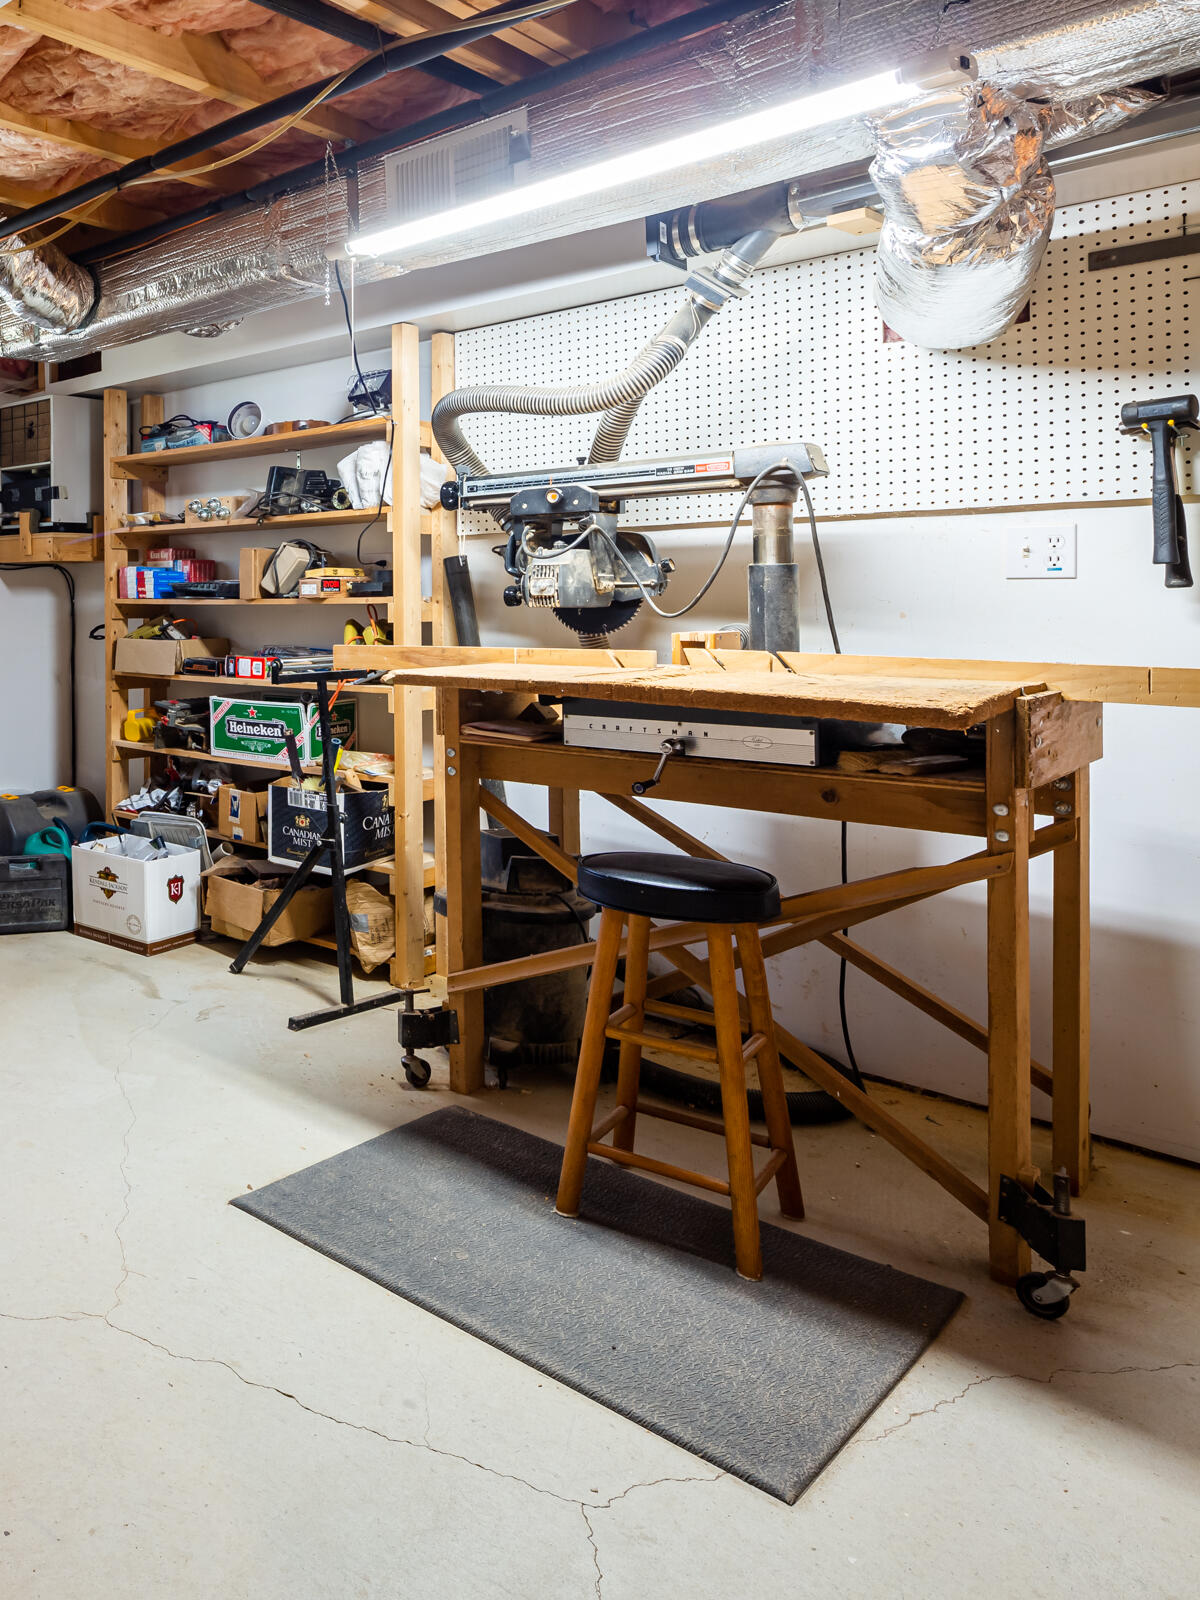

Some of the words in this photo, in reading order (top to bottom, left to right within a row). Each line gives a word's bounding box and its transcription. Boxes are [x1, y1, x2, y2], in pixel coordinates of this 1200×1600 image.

[228, 721, 282, 737] Heineken
[589, 723, 708, 737] CRAFTSMAN
[282, 826, 321, 841] CANADIAN
[292, 837, 312, 848] MIST
